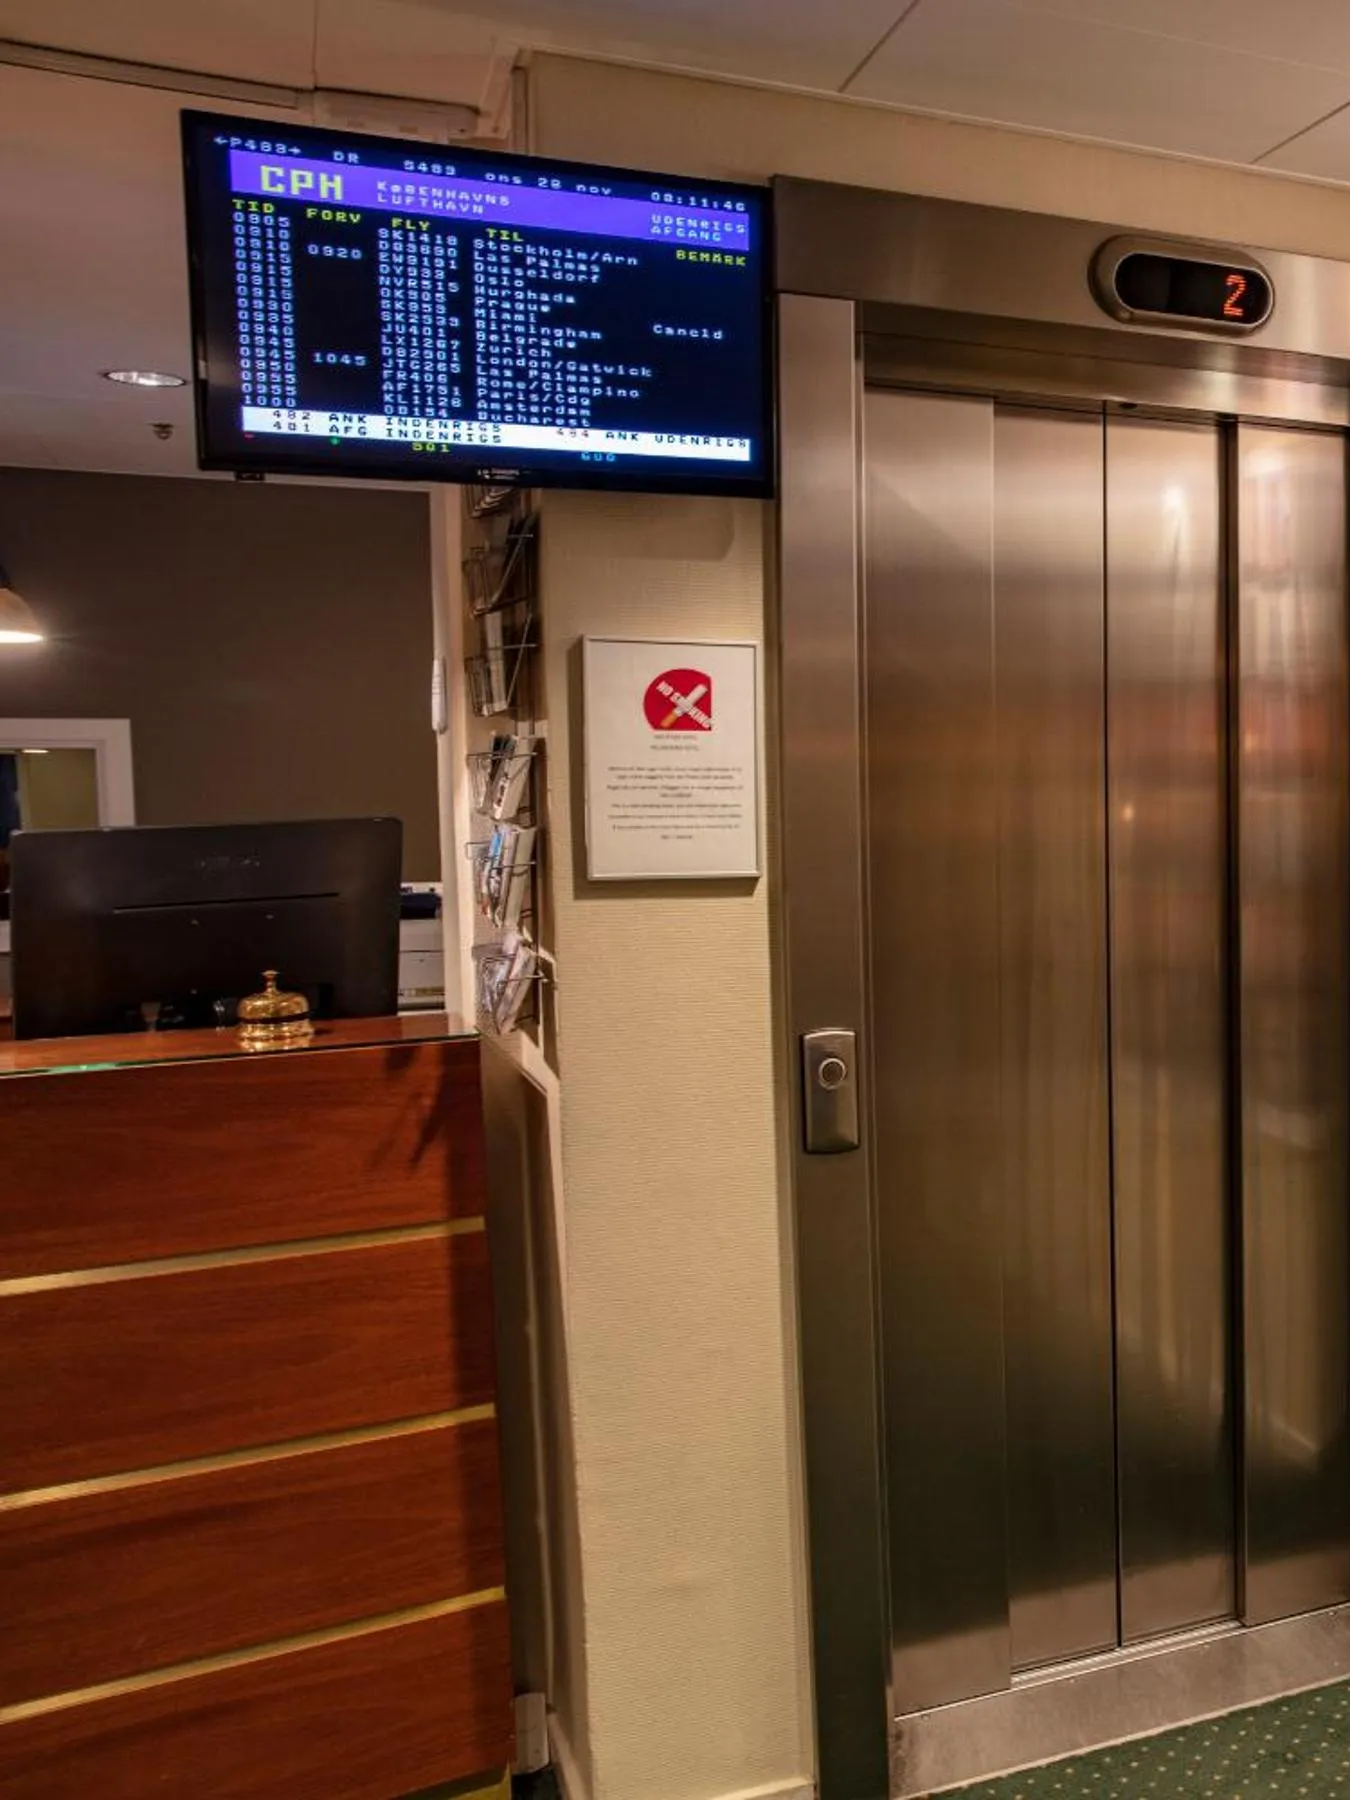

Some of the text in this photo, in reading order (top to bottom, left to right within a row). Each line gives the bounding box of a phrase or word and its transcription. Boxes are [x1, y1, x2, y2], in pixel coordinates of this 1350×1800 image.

[260, 164, 343, 201] CPH
[333, 150, 359, 164] DR
[485, 172, 522, 185] ons
[576, 184, 612, 196] nov
[377, 191, 483, 215] LUFTHAVN
[232, 198, 275, 214] TID
[306, 207, 361, 224] FORV
[391, 217, 430, 232] FLY
[486, 228, 523, 243] TIL
[651, 213, 746, 234] UDENRIGS
[651, 225, 722, 242] AFGANG
[473, 238, 637, 266] Stockholm/Arn
[473, 250, 511, 264] Las
[526, 255, 600, 273] Palmas
[473, 261, 600, 285] Dusseldorf
[474, 273, 524, 288] Oslo
[474, 284, 575, 306] Hurghada
[474, 296, 550, 314] Prague
[1223, 274, 1247, 316] 2
[475, 307, 538, 323] Miami
[475, 319, 601, 341] Birmingham
[475, 330, 576, 350] Belgrade
[475, 342, 551, 358] Zurich
[311, 351, 366, 366] 1045
[476, 365, 513, 378] Las
[528, 369, 602, 385] Palmas
[476, 353, 651, 378] London/Gatwick
[241, 394, 297, 409] 1000
[477, 410, 590, 428] Bucharest
[477, 399, 590, 417] Amsterdam
[328, 412, 368, 425] ANK
[384, 416, 502, 434] INDENRIGS
[605, 430, 640, 442] ANK
[654, 434, 748, 449] UDENRIGS
[328, 424, 368, 437] AFG
[384, 427, 502, 445] INDENRIGS
